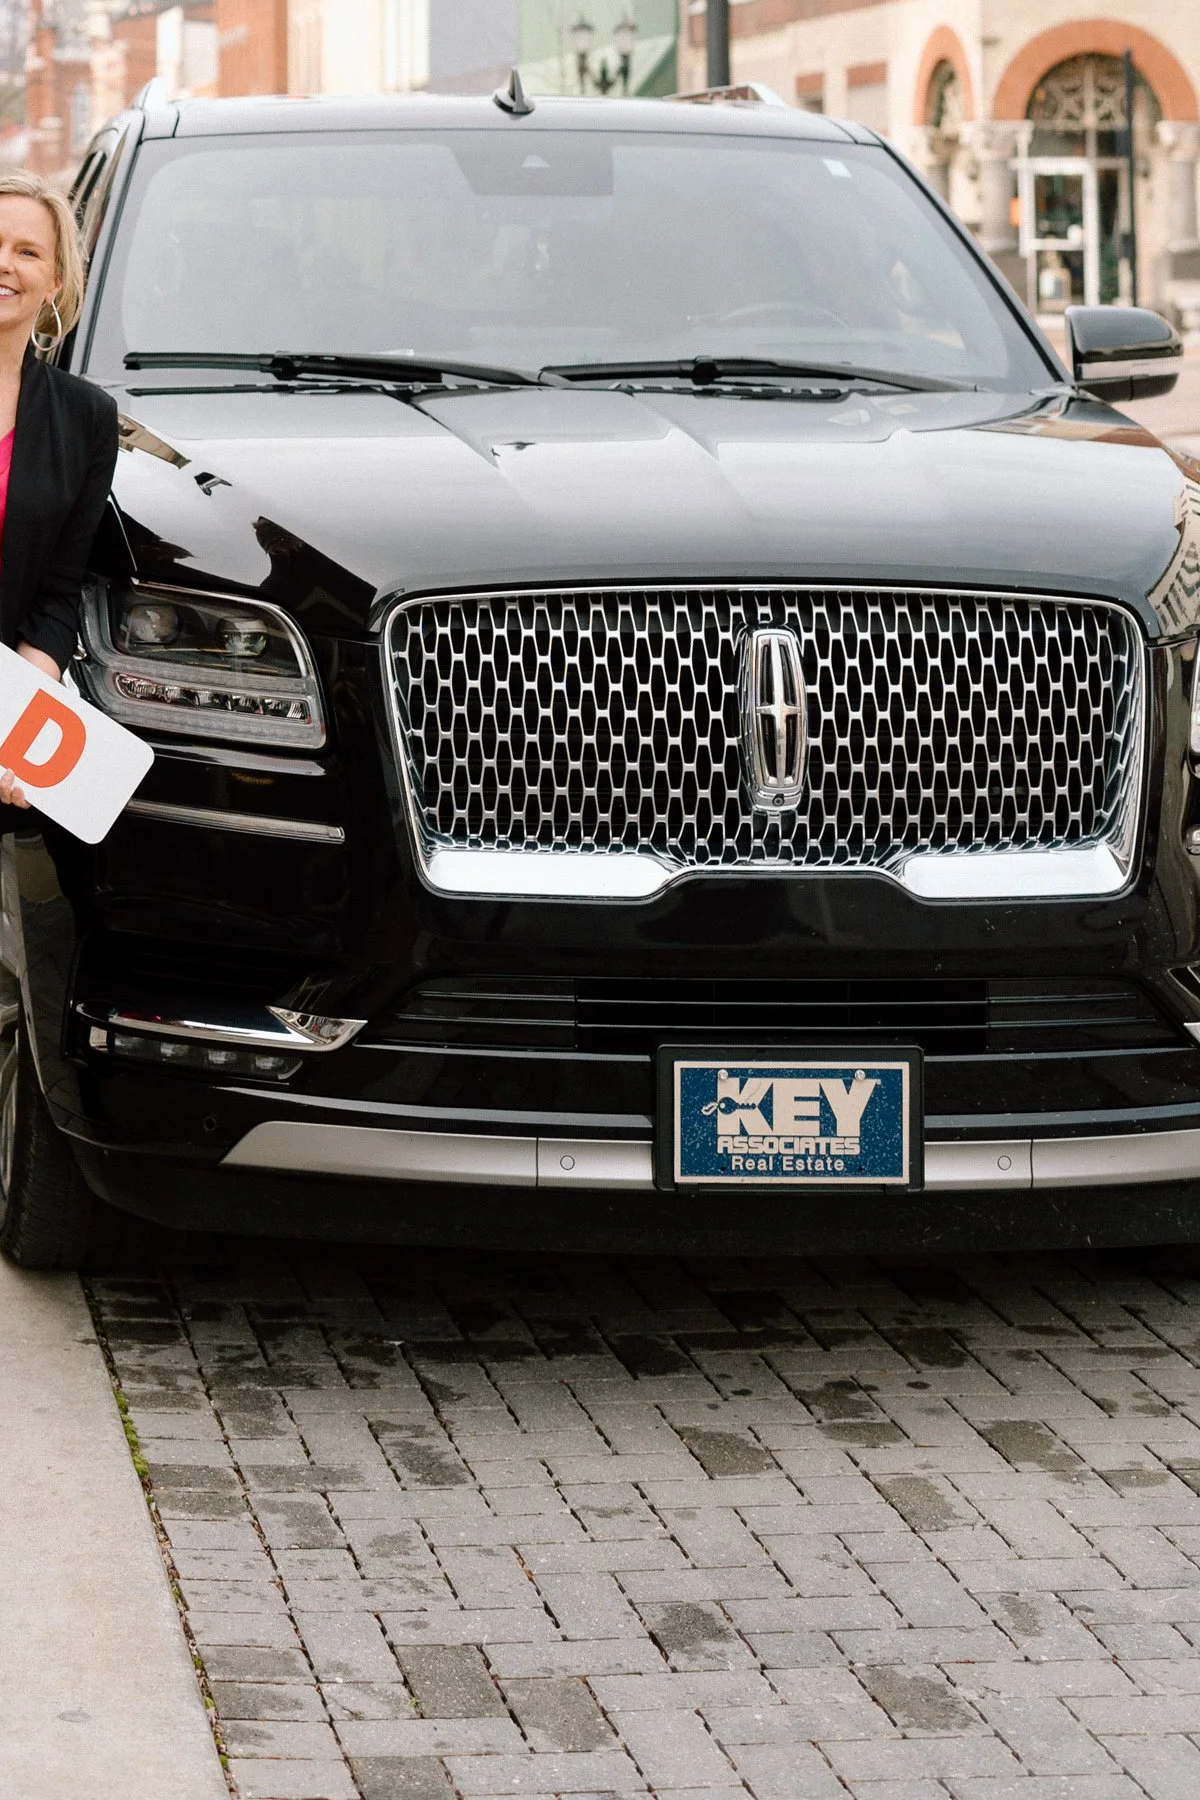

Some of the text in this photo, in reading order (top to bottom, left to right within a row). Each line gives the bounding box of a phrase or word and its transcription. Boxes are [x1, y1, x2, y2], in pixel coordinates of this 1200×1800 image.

[716, 1077, 878, 1136] KEY
[717, 1136, 861, 1155] ASSOCIATES
[731, 1156, 845, 1171] Real Estate
